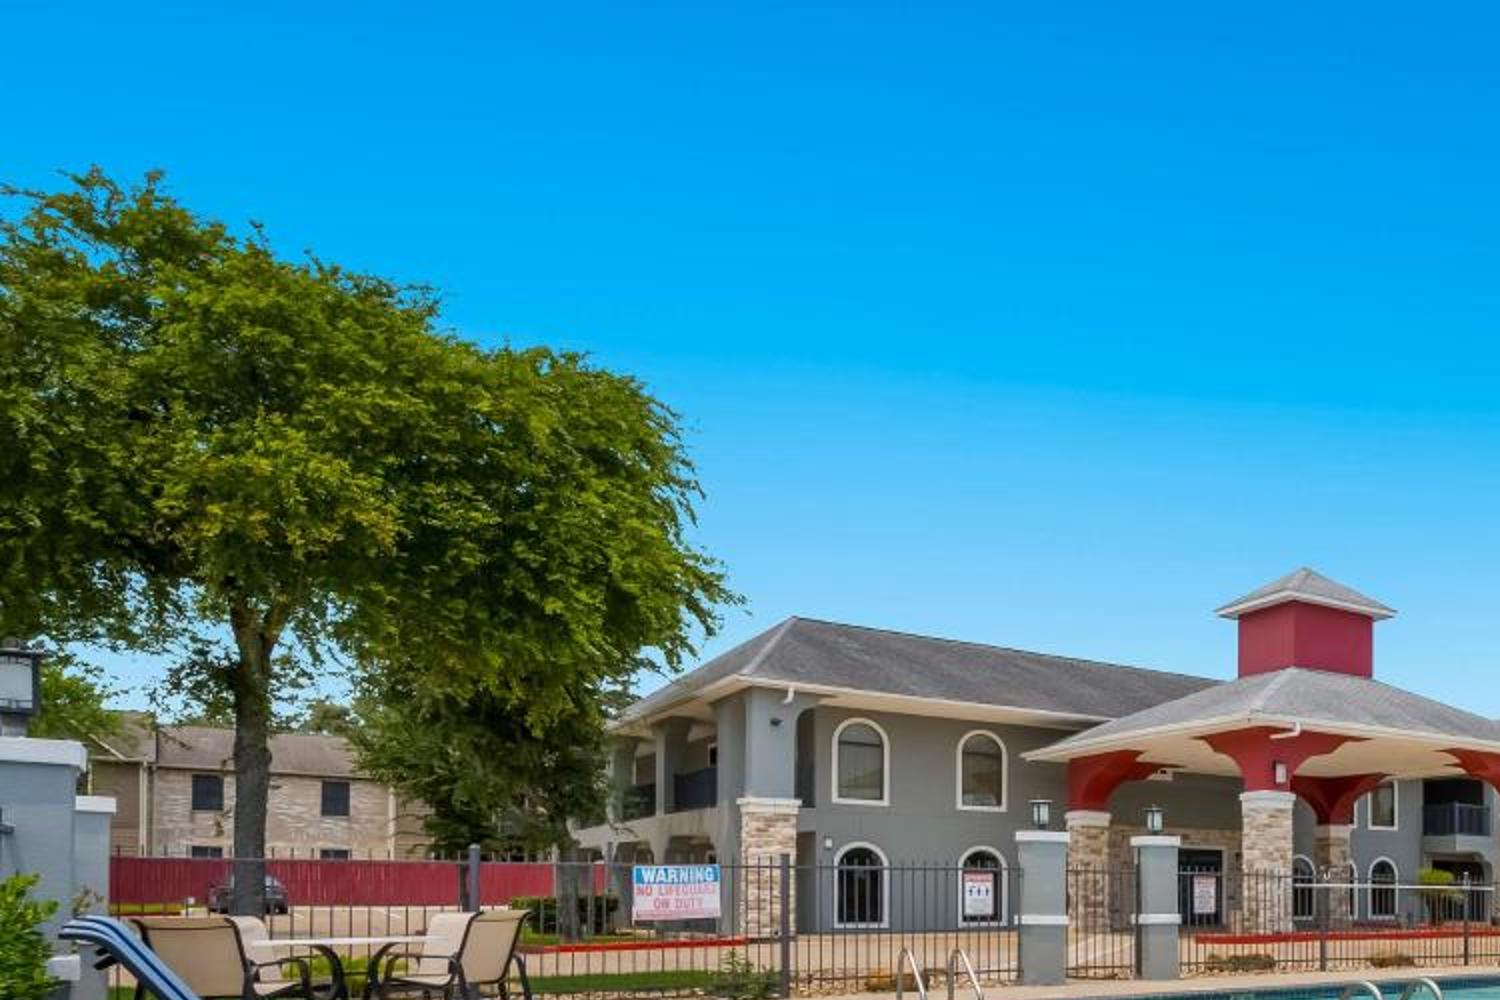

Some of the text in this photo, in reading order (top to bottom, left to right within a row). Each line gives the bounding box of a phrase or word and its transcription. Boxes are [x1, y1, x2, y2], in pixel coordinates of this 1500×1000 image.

[641, 866, 715, 884] WARNING
[635, 885, 652, 896] NO
[653, 897, 670, 908] ON
